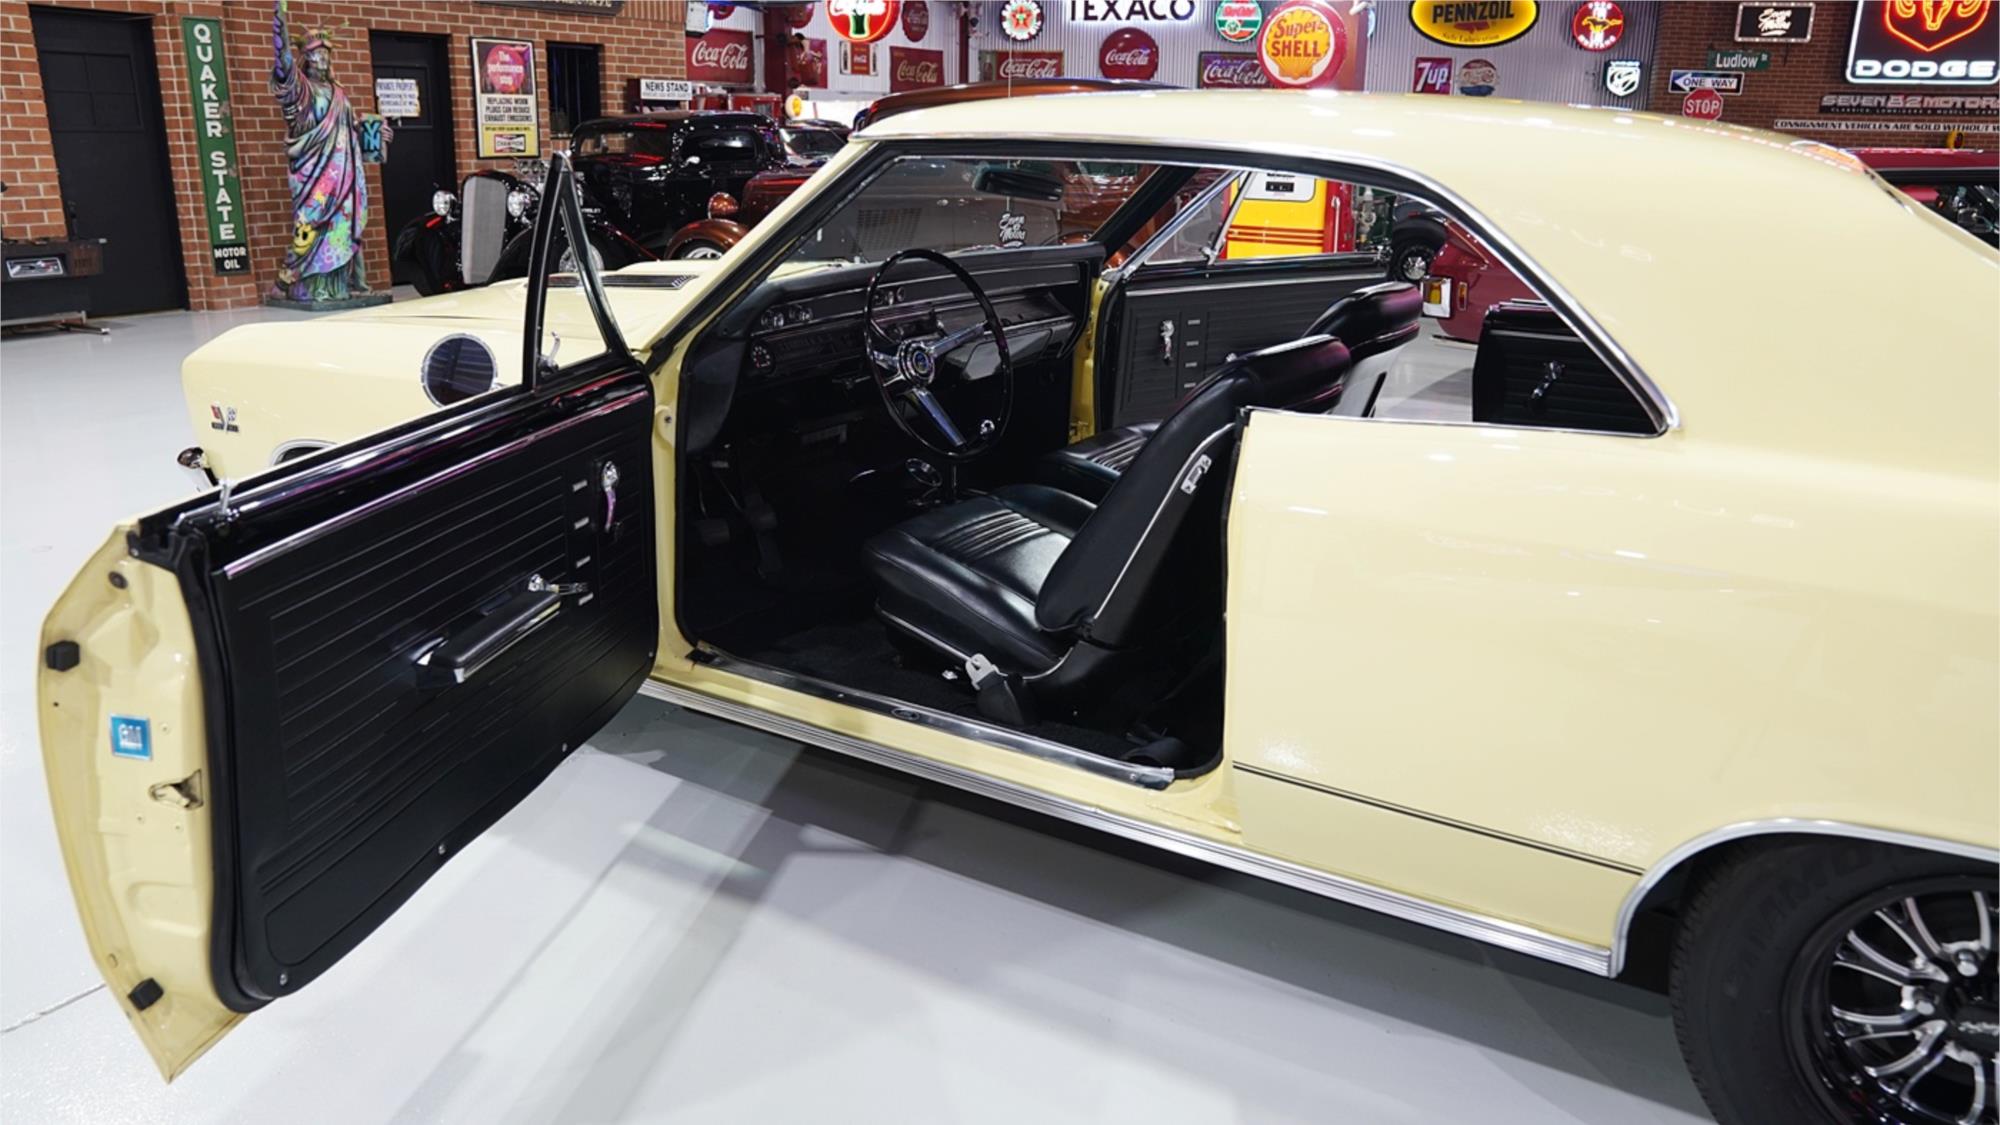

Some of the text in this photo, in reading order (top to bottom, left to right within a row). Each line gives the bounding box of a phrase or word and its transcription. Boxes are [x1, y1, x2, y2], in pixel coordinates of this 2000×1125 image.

[1071, 0, 1196, 21] TEXACO
[1432, 0, 1515, 23] PENNZOIL
[692, 40, 748, 69] Coca-Cola
[1271, 40, 1321, 58] SHELL
[1000, 58, 1059, 78] Coca-Cola
[1715, 53, 1759, 68] Ludlow
[1855, 59, 1997, 78] DODGE
[1415, 62, 1449, 92] 7up
[1683, 77, 1735, 88] ONE WAY
[645, 81, 689, 92] NEWS STAND
[1685, 99, 1720, 114] STOP
[1821, 95, 1887, 107] SEVEN
[193, 23, 236, 241] QUAKER STATE
[1775, 120, 1841, 129] CONSIGNMENT
[1845, 121, 1891, 130] VEHICLES
[1893, 122, 1912, 130] ARE
[1914, 123, 1941, 131] SOLD
[1942, 123, 1989, 132] WITHOUT
[214, 246, 246, 258] MOTOR
[223, 259, 240, 270] OIL
